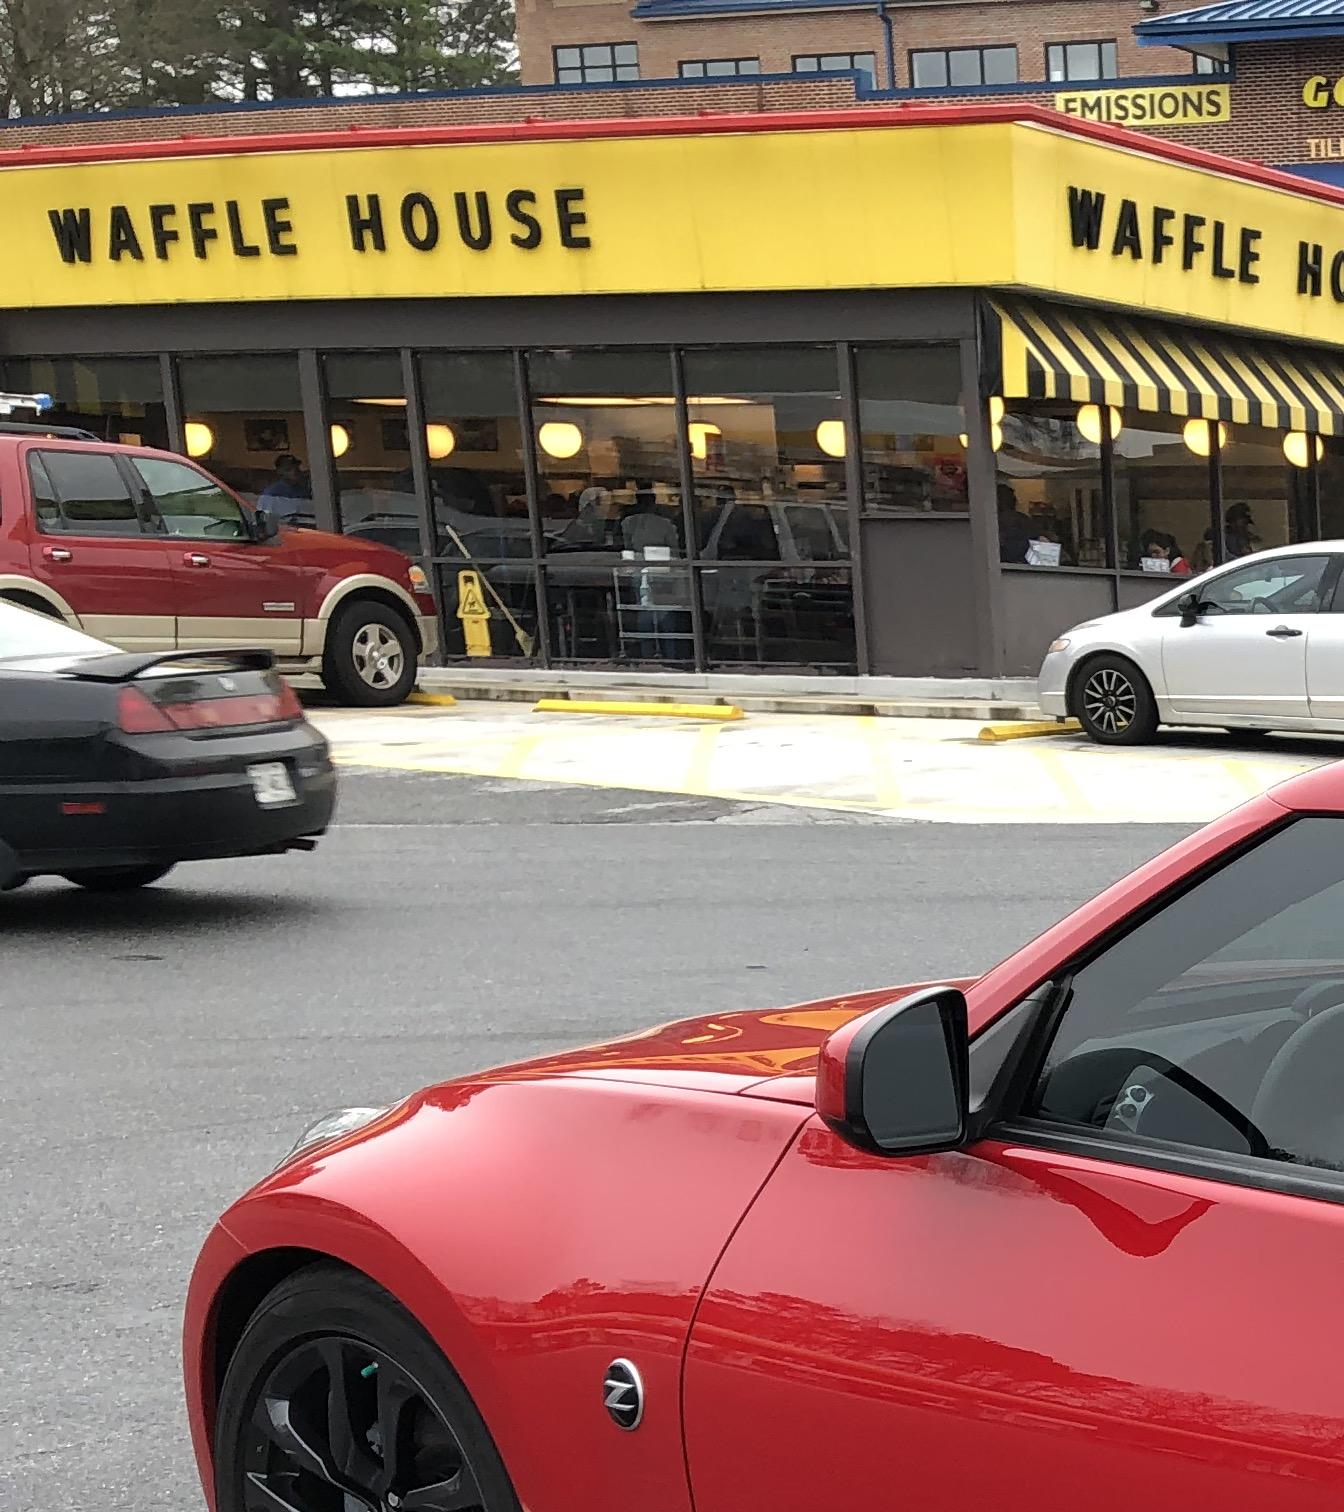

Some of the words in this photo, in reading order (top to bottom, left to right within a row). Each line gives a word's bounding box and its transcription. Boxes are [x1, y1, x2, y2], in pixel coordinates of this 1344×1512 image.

[48, 197, 299, 265] WAFFLE
[345, 187, 593, 253] HOUSE
[1067, 184, 1263, 286] WAFFLE
[603, 1379, 637, 1412] Z
